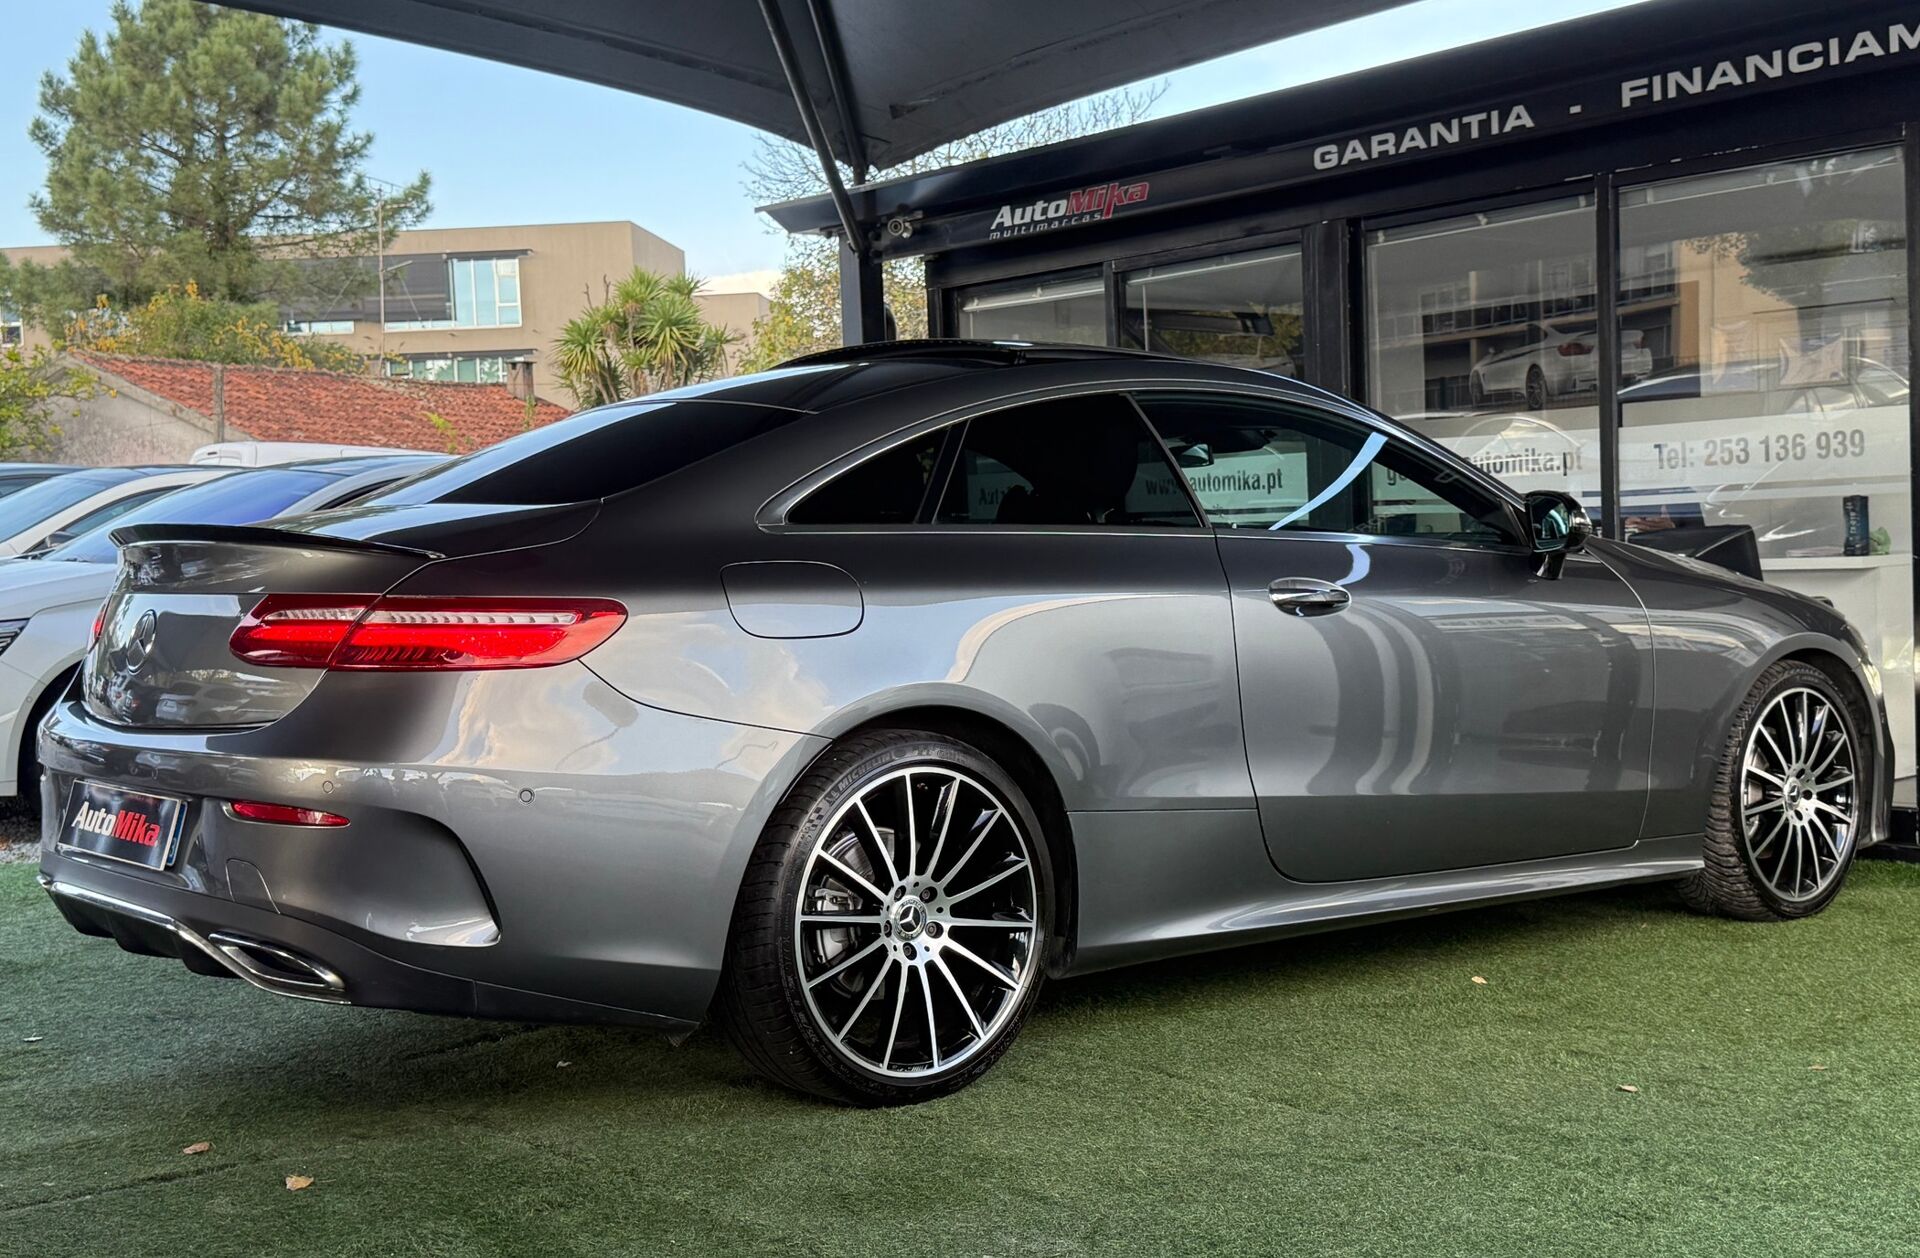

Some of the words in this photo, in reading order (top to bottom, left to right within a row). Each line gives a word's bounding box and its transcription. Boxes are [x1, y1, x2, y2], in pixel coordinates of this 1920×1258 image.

[1313, 104, 1535, 170] GARANTIA
[989, 212, 1100, 240] multimarcas
[990, 182, 1149, 230] AutoMika
[1653, 442, 1694, 470] Tel:
[1704, 438, 1750, 466] 253
[1759, 433, 1806, 462] 136
[1816, 429, 1865, 459] 939
[71, 801, 161, 847] AutoMika
